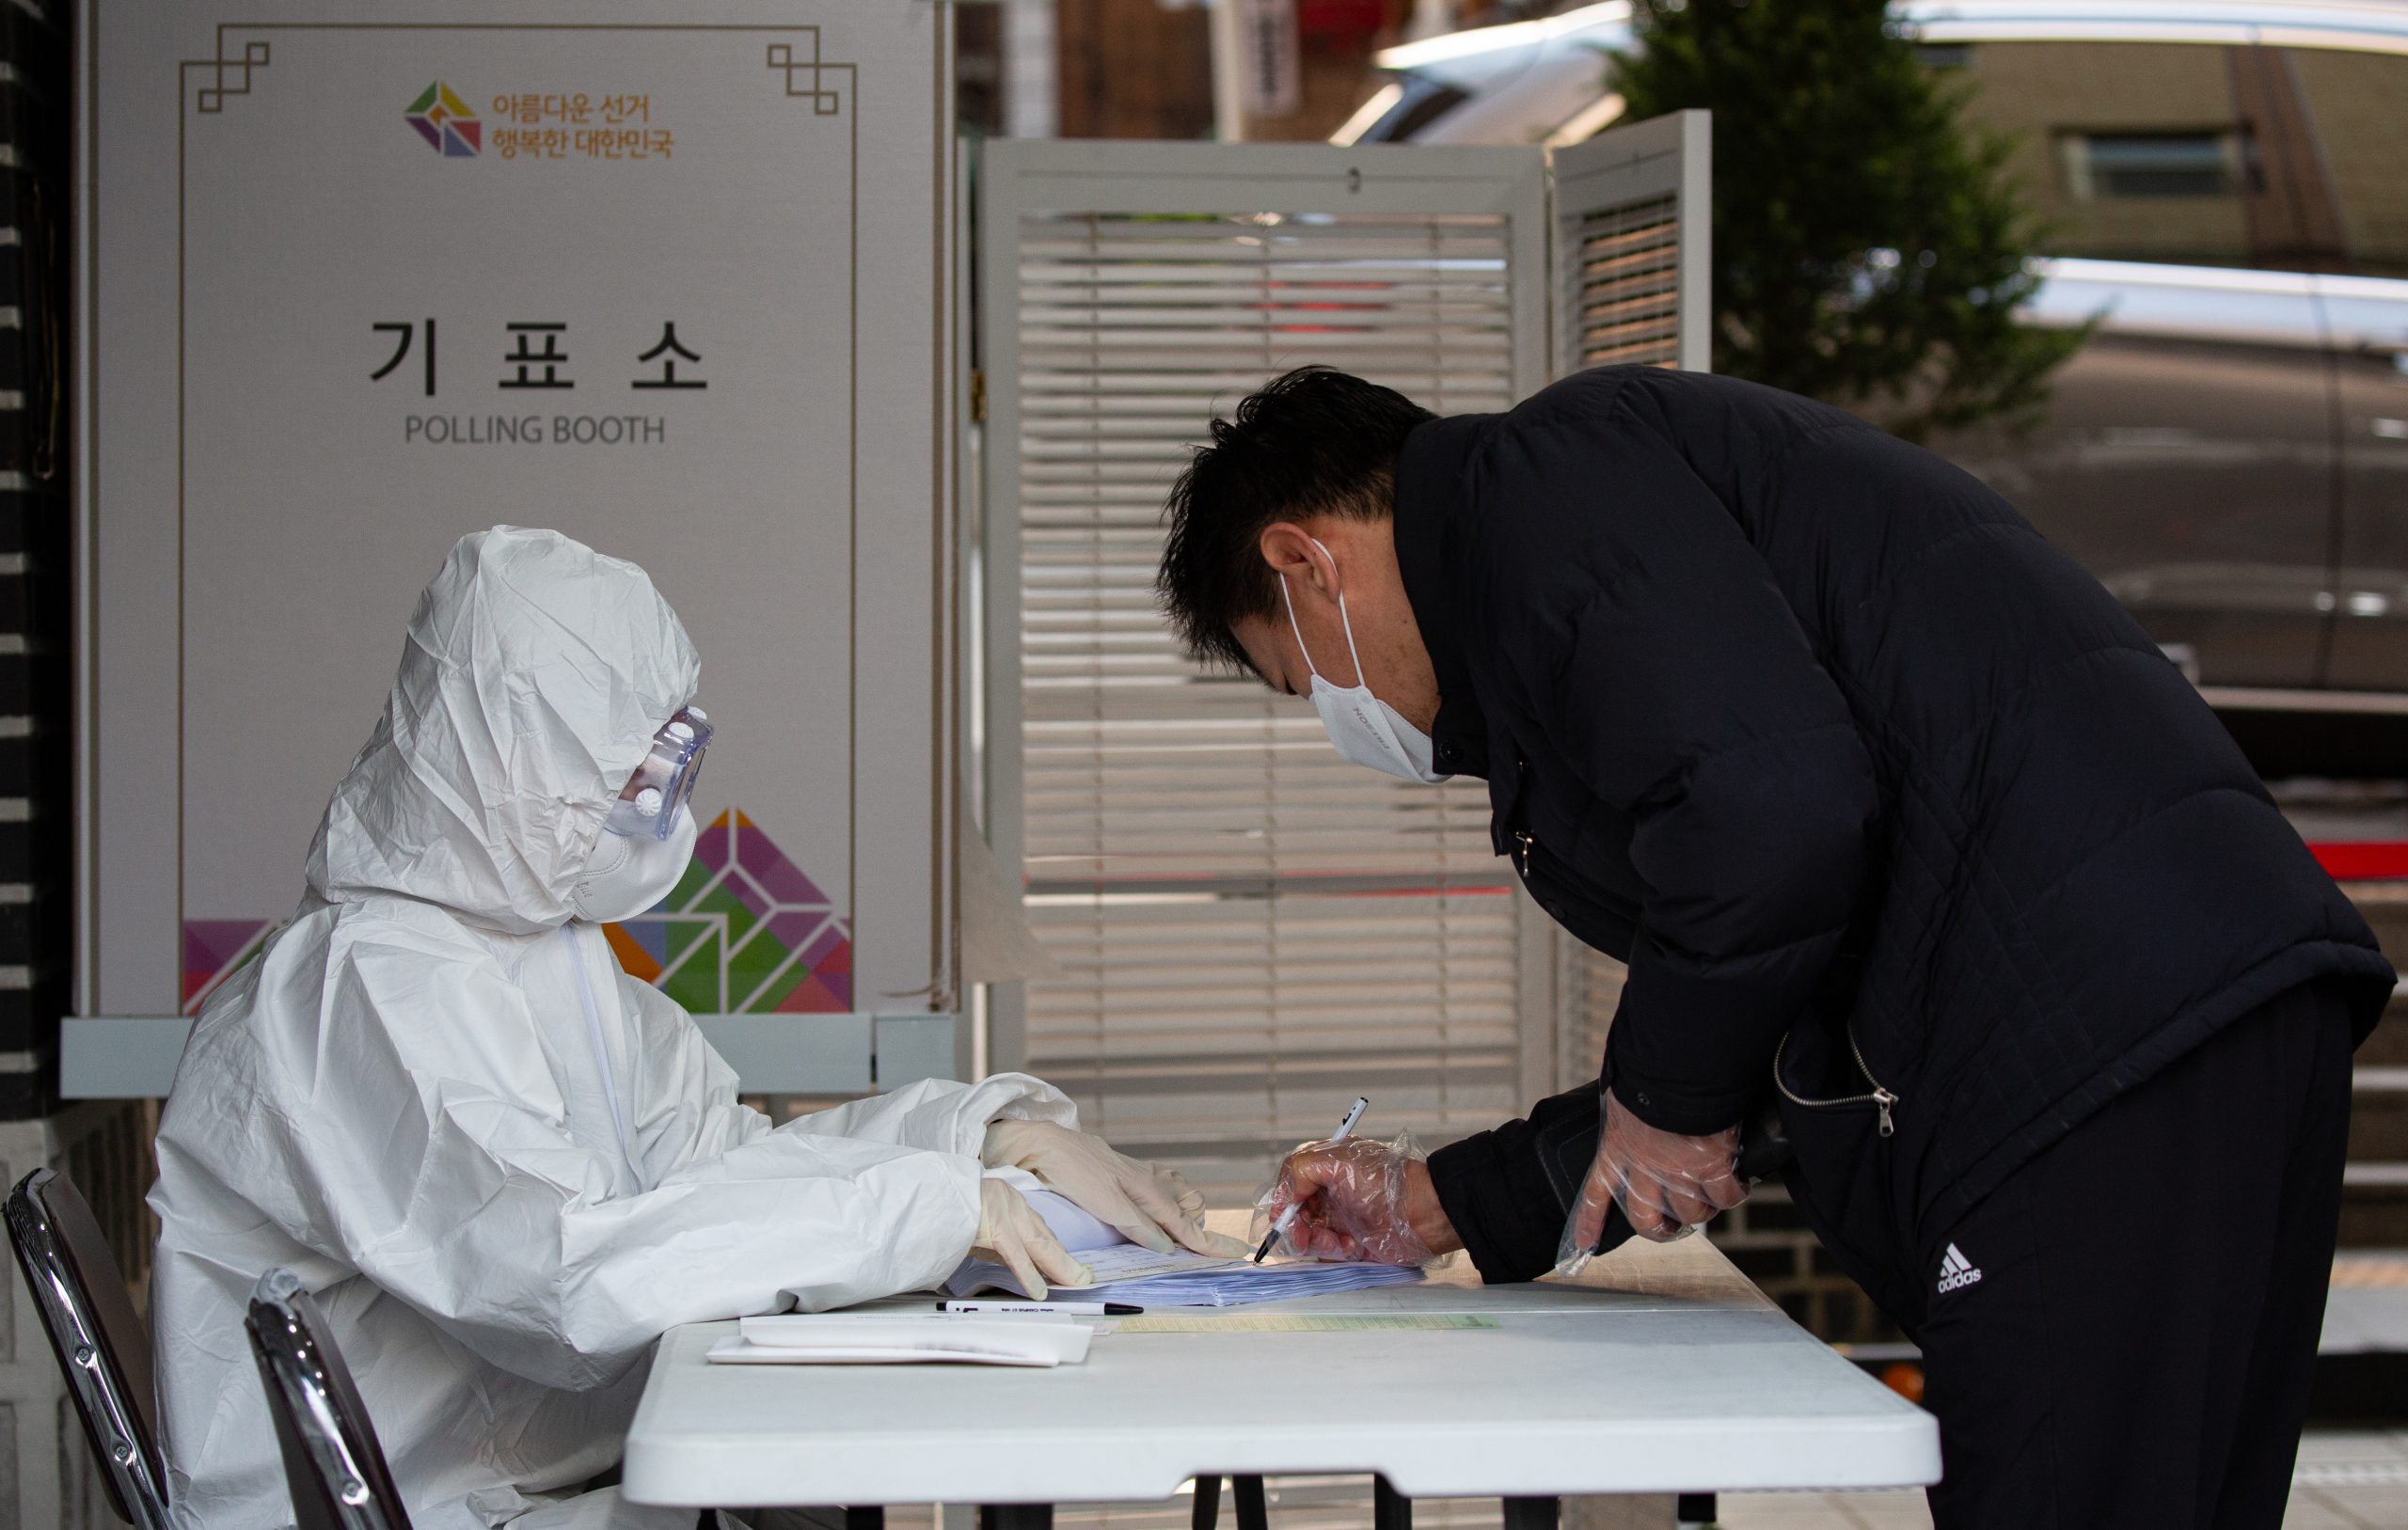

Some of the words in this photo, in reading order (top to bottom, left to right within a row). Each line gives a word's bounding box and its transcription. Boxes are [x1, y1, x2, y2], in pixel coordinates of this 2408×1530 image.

[493, 93, 591, 123] 아름다운
[600, 94, 649, 123] 선거
[493, 130, 569, 159] 행복한
[575, 129, 673, 159] 대한민국
[405, 415, 543, 444] POLLING
[553, 416, 664, 444] BOOTH
[1938, 1268, 1982, 1294] adidas
